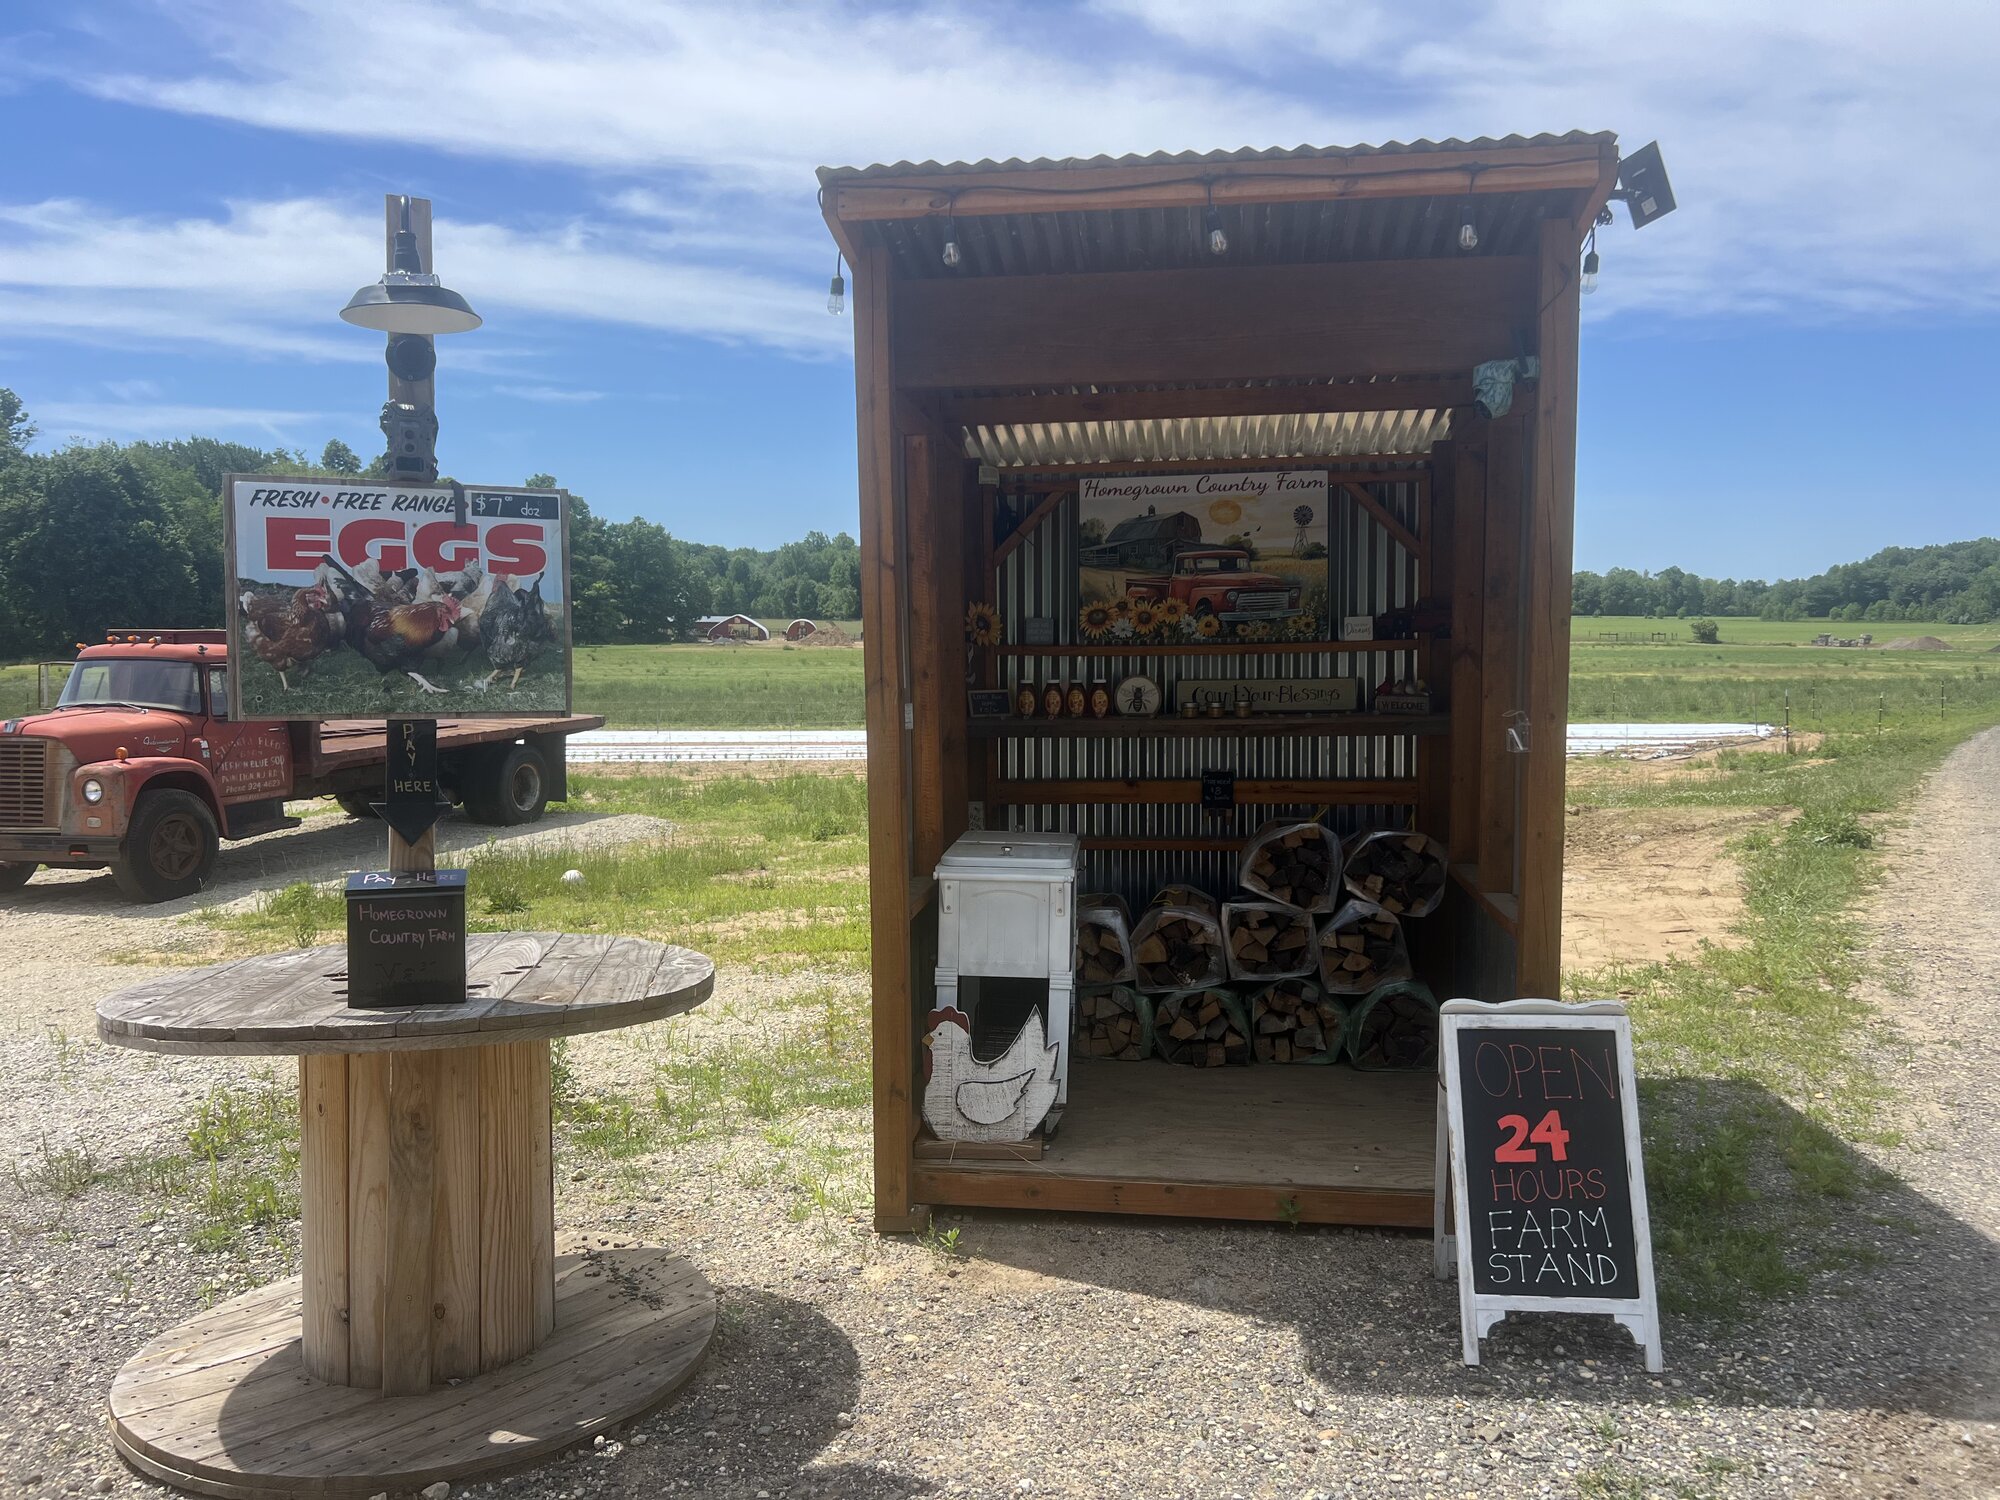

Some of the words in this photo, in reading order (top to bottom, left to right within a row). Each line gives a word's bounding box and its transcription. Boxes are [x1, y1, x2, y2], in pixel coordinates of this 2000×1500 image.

[249, 489, 321, 509] FRESH
[332, 492, 387, 511] FREE
[391, 495, 457, 513] RANGE
[1084, 479, 1191, 501] Homegrown
[1196, 475, 1270, 497] Country
[1276, 472, 1326, 491] Farm
[265, 516, 548, 577] EGGS
[1192, 684, 1239, 703] Count
[1243, 685, 1272, 703] Your
[1279, 685, 1341, 706] Blessings
[1381, 701, 1425, 711] WELCOME
[402, 723, 416, 767] PAY
[394, 779, 431, 793] HERE
[363, 873, 397, 885] PAY
[416, 871, 458, 882] HERE
[359, 903, 448, 921] HOMEGROWN
[369, 928, 425, 950] COUNTRY
[428, 928, 456, 943] FARM
[1475, 1042, 1616, 1100] OPEN
[1494, 1109, 1571, 1163] 24
[1490, 1168, 1608, 1203] HOURS
[1488, 1206, 1613, 1250] FARM
[1488, 1252, 1619, 1286] STAND
